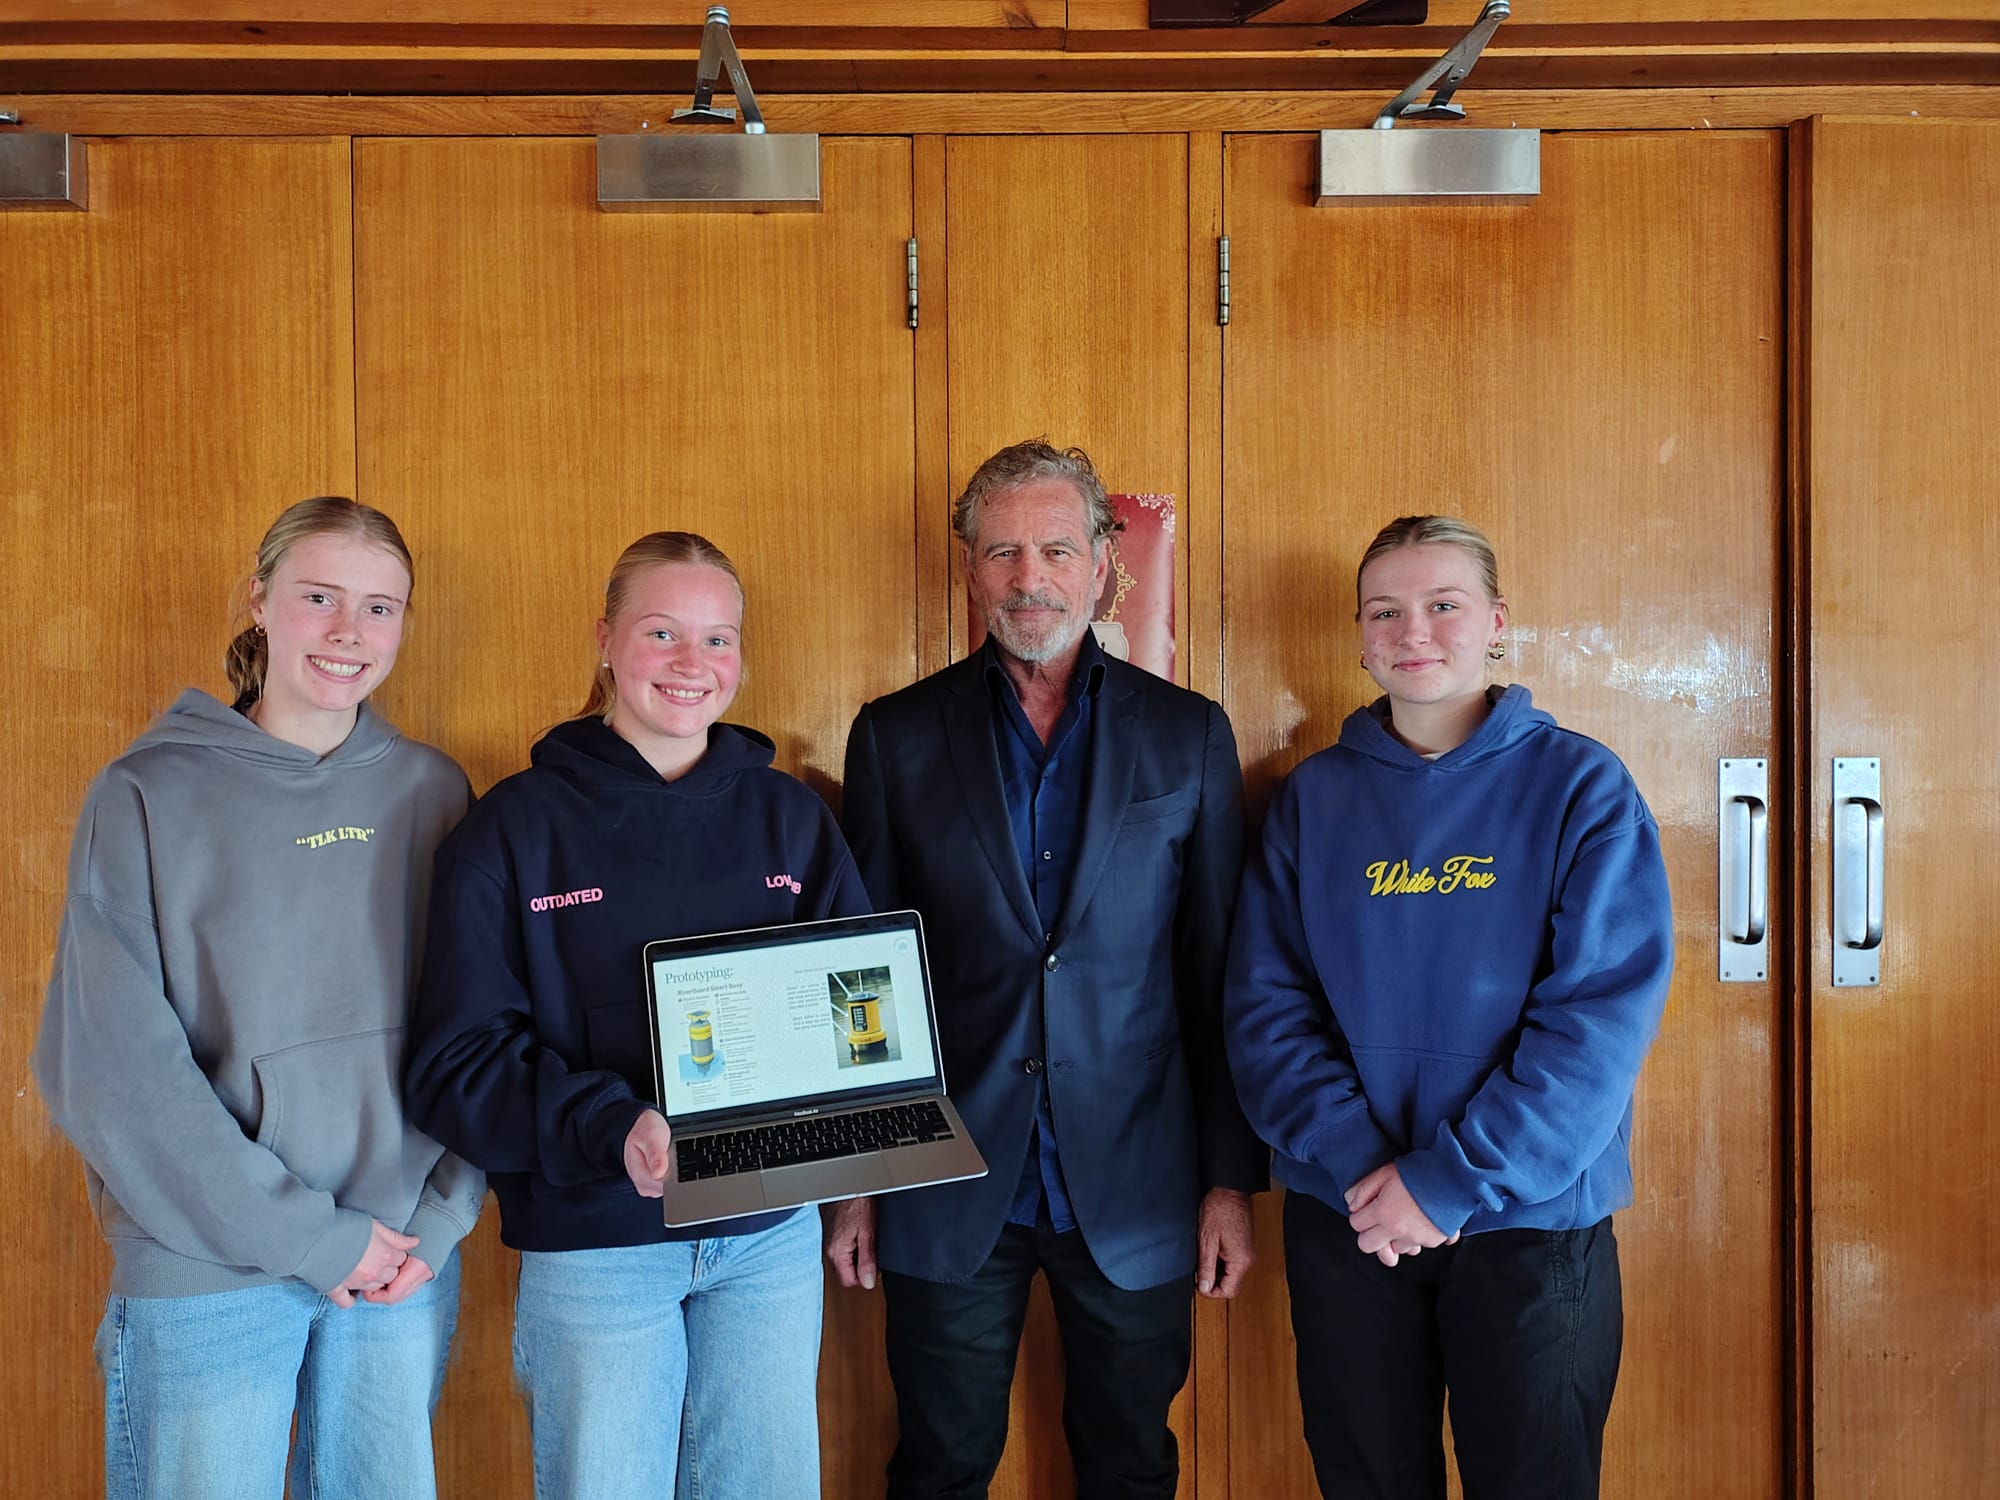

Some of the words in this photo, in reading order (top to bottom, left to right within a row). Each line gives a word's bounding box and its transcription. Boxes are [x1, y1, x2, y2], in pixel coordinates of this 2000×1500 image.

[1365, 859, 1437, 896] White
[1438, 856, 1497, 894] Fox
[530, 888, 603, 912] OUTDATED
[664, 966, 734, 984] Prototyping:
